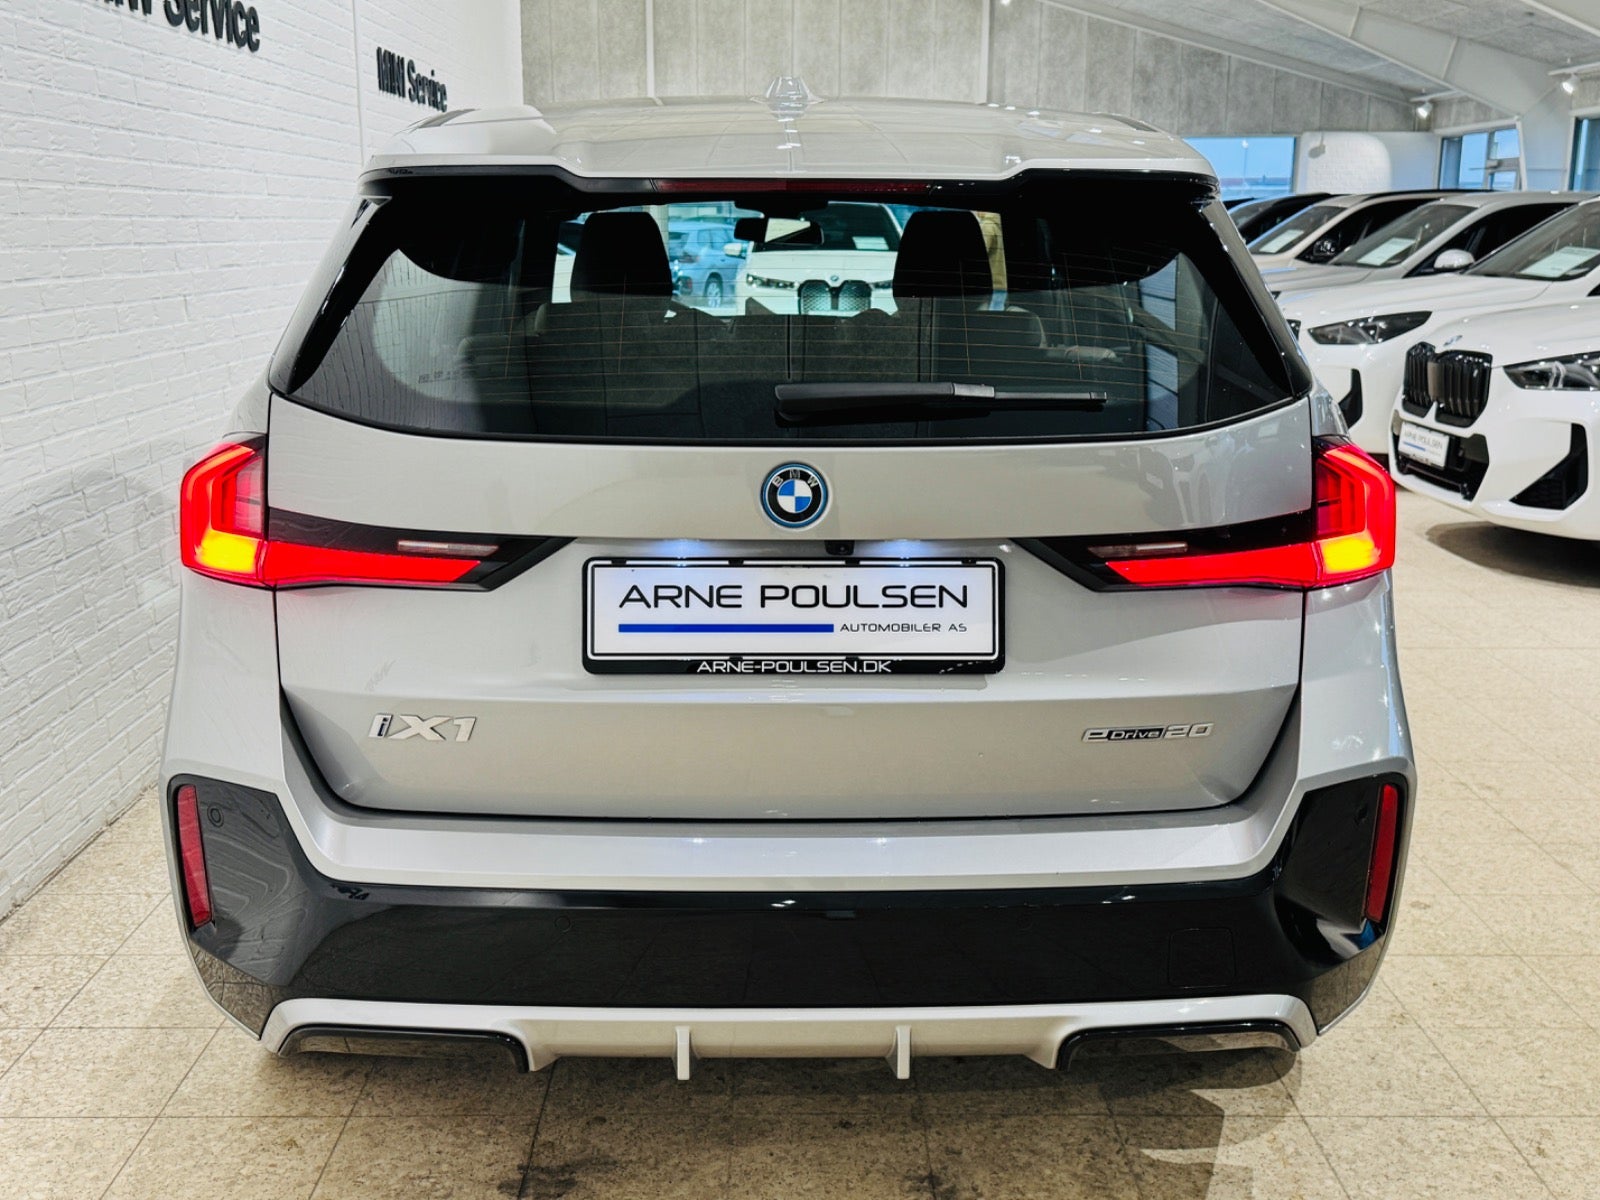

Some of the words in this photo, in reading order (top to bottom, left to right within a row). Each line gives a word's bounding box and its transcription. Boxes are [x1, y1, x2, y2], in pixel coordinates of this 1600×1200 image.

[376, 46, 406, 98] MINI
[407, 59, 447, 113] Service
[772, 469, 819, 488] BMW
[619, 585, 743, 608] ARNE
[760, 585, 967, 608] POULSEN
[839, 623, 941, 633] AUTOMOBILER
[948, 623, 967, 633] AS
[696, 660, 892, 673] ARNE-POULSEN.DK
[368, 713, 477, 742] iX1
